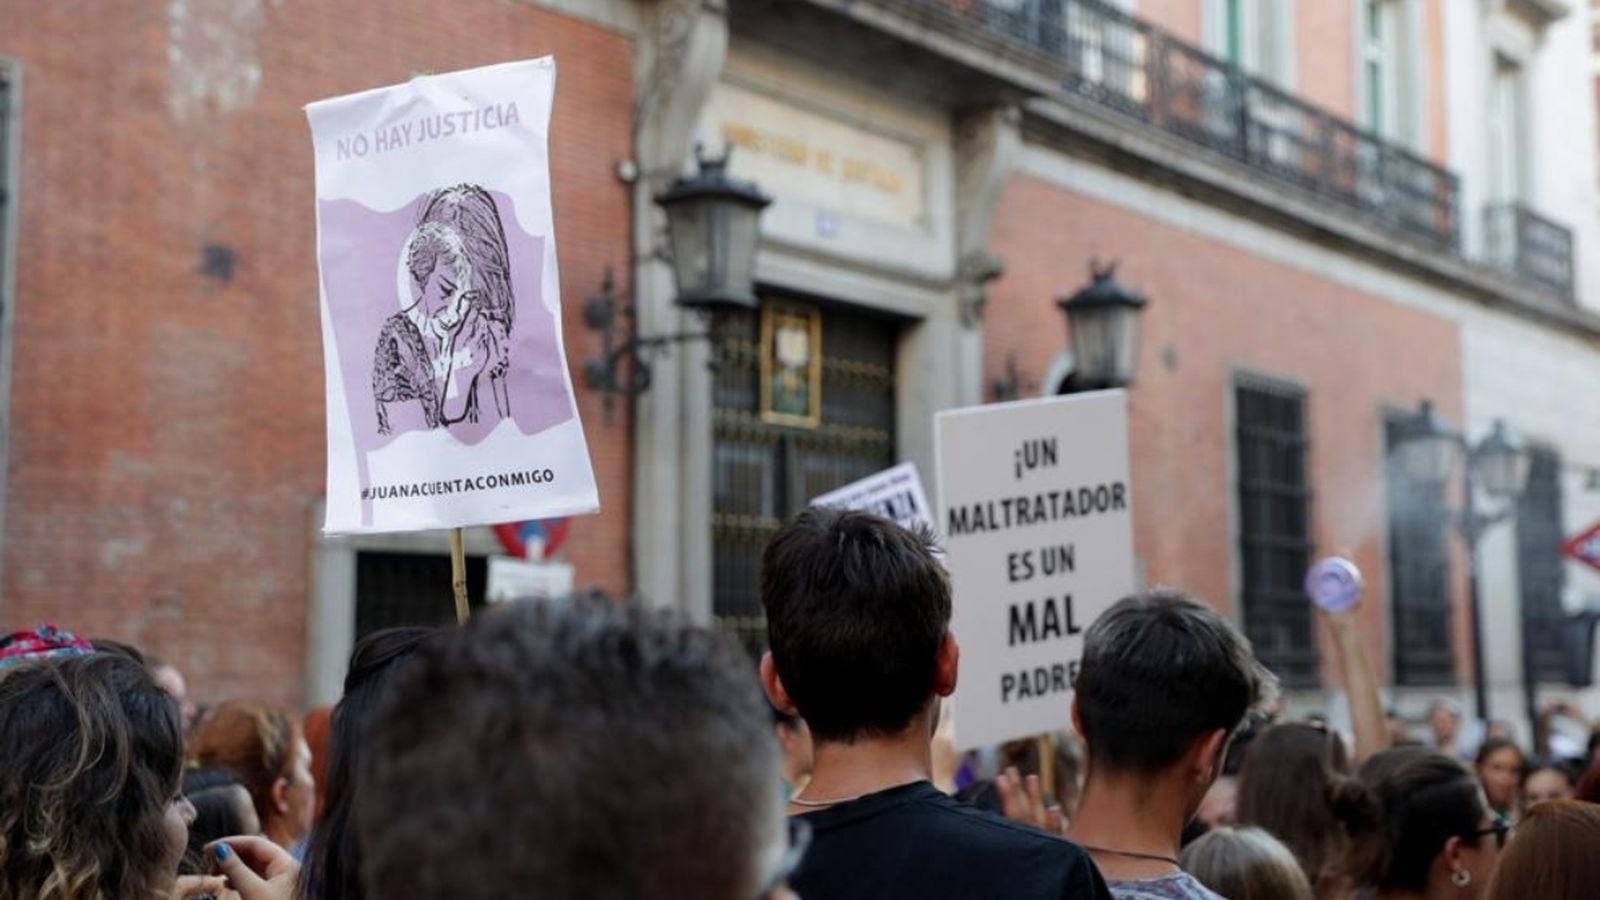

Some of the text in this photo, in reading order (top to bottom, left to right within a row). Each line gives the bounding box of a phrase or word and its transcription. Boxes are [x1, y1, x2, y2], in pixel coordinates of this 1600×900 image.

[336, 101, 520, 161] NO HAY JUSTICIA
[1014, 436, 1057, 479] ¡UN
[361, 468, 554, 501] #JUANACUENTACONMIGO
[949, 482, 1127, 536] MALTRATADOR
[1008, 544, 1075, 582] ES UN
[1009, 594, 1081, 647] MAL
[1002, 660, 1080, 702] PADRE
